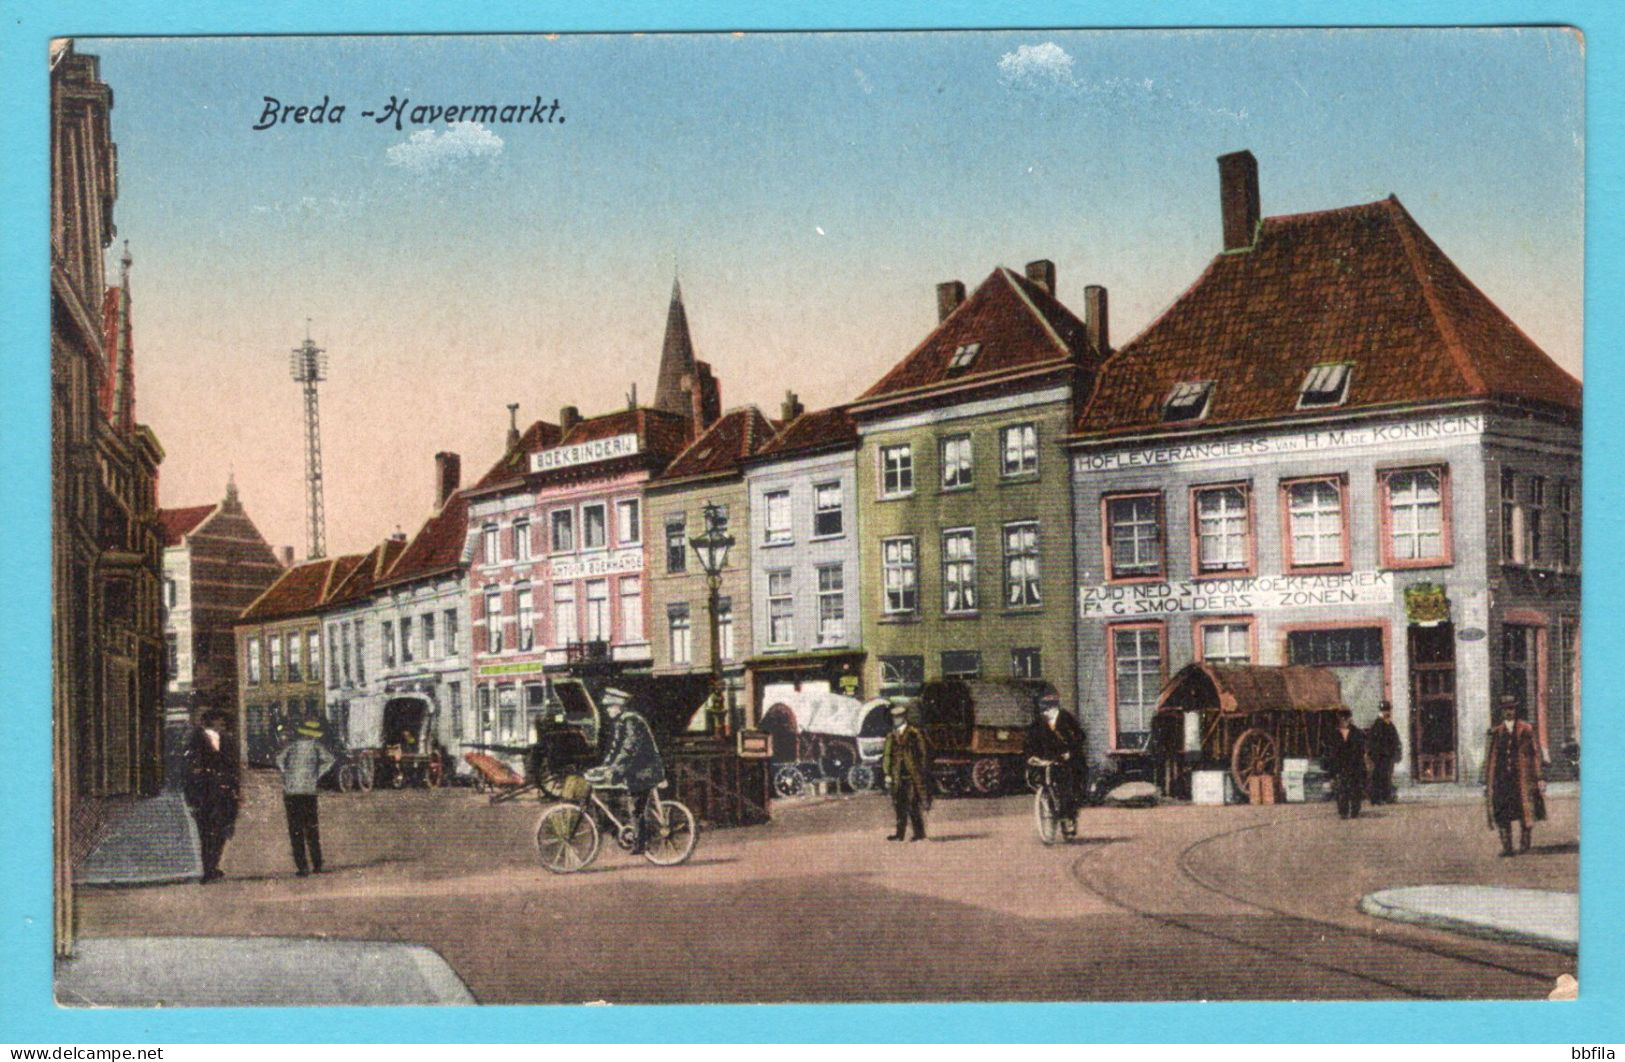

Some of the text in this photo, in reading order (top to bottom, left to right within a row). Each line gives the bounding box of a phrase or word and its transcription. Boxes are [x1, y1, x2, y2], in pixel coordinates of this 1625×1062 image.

[537, 439, 632, 468] BOEKBINDERIJ
[1078, 438, 1270, 471] HOFLEVERANCIERS
[1373, 417, 1479, 442] KONINGIN
[1279, 589, 1357, 606] ZONEN
